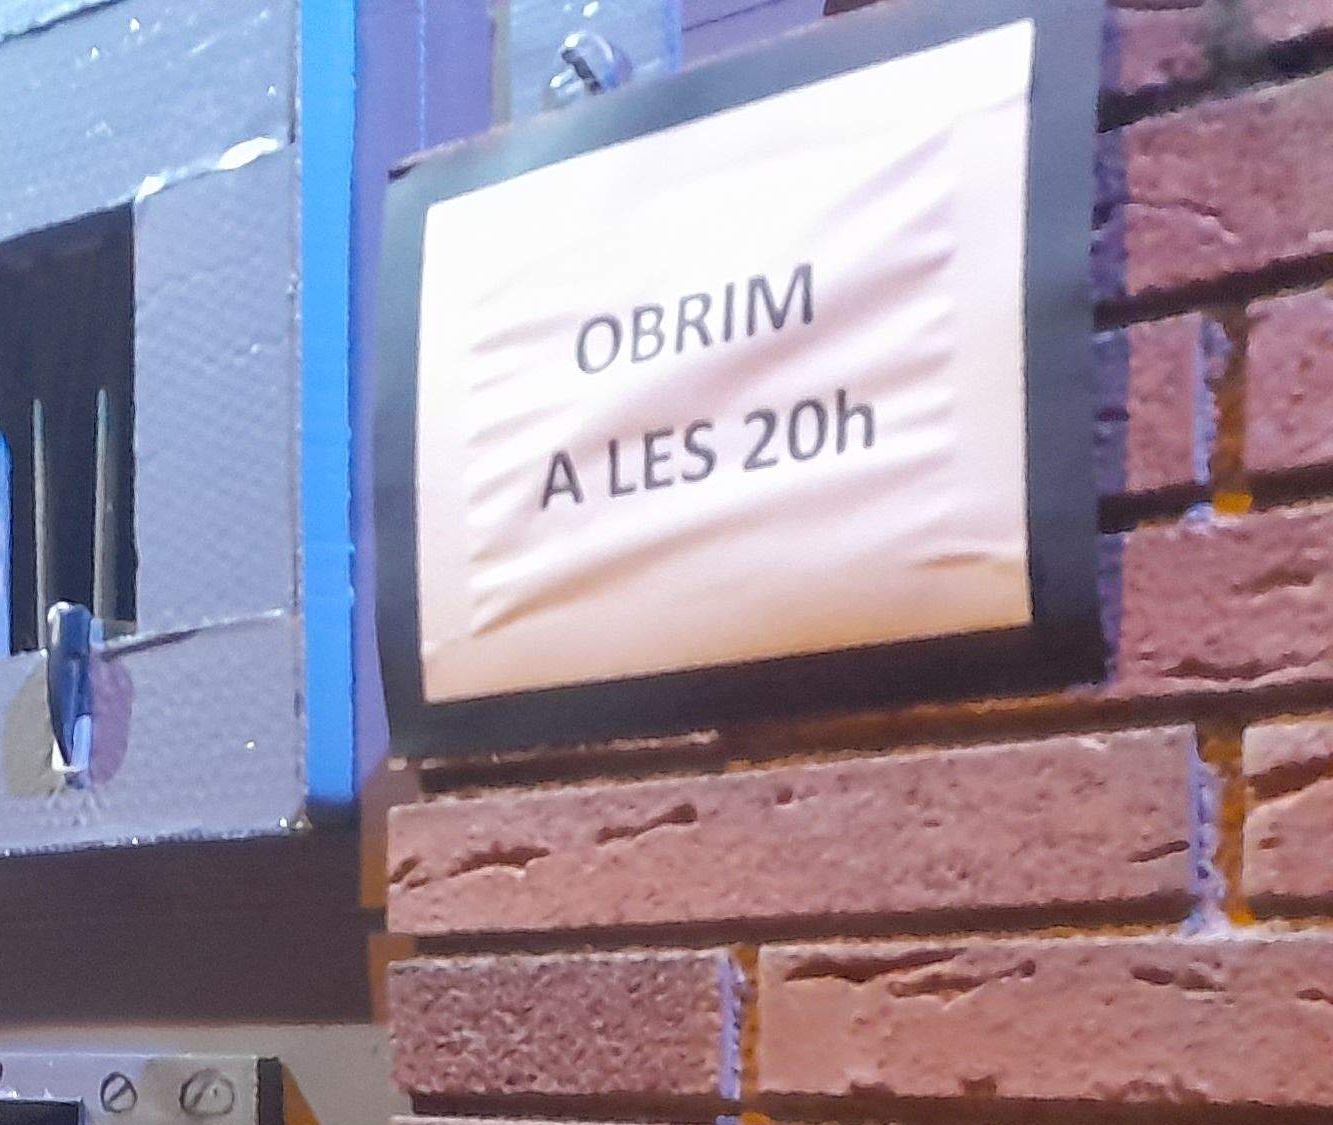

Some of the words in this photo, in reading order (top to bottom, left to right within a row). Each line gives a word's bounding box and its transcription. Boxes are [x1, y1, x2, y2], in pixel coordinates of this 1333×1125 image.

[576, 263, 814, 374] OBRIM
[540, 451, 583, 510] A
[608, 419, 716, 497] LES
[743, 389, 874, 472] 20h
